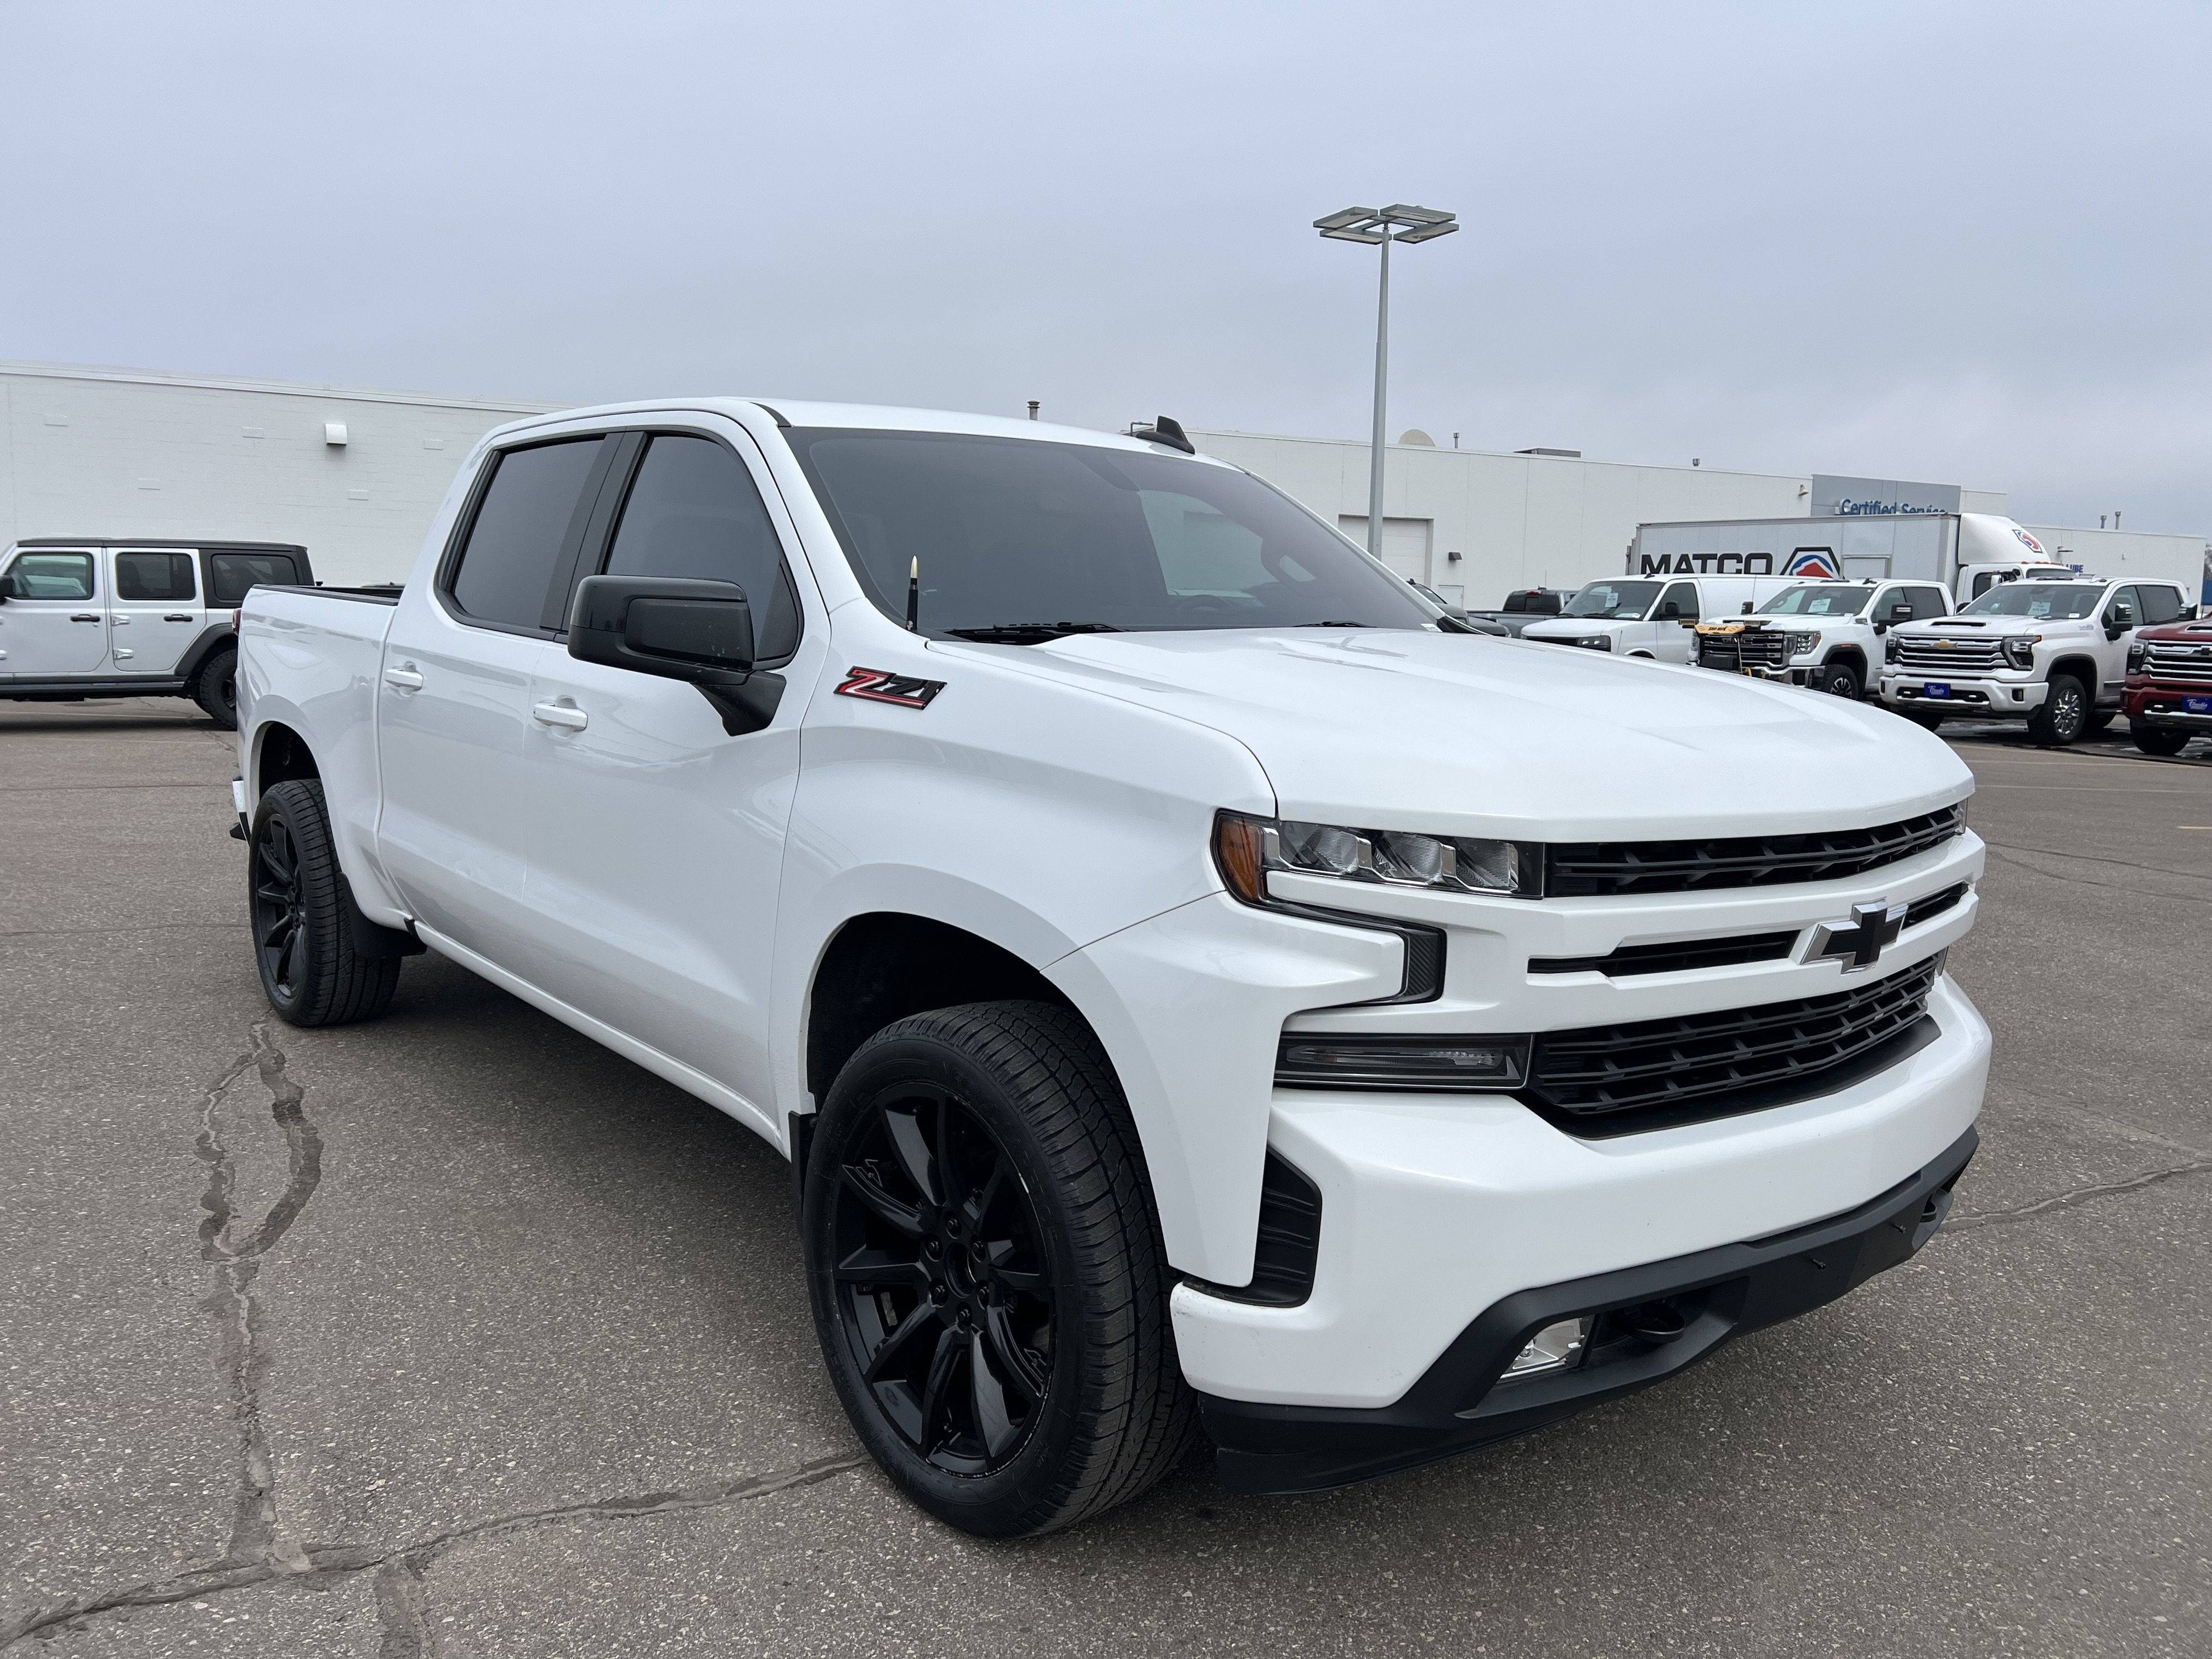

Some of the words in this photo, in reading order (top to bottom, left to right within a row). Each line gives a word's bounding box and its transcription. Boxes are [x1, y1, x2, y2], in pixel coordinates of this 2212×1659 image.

[1840, 499, 1897, 514] Certified
[1641, 553, 1773, 574] MATCO
[833, 665, 948, 710] Z71
